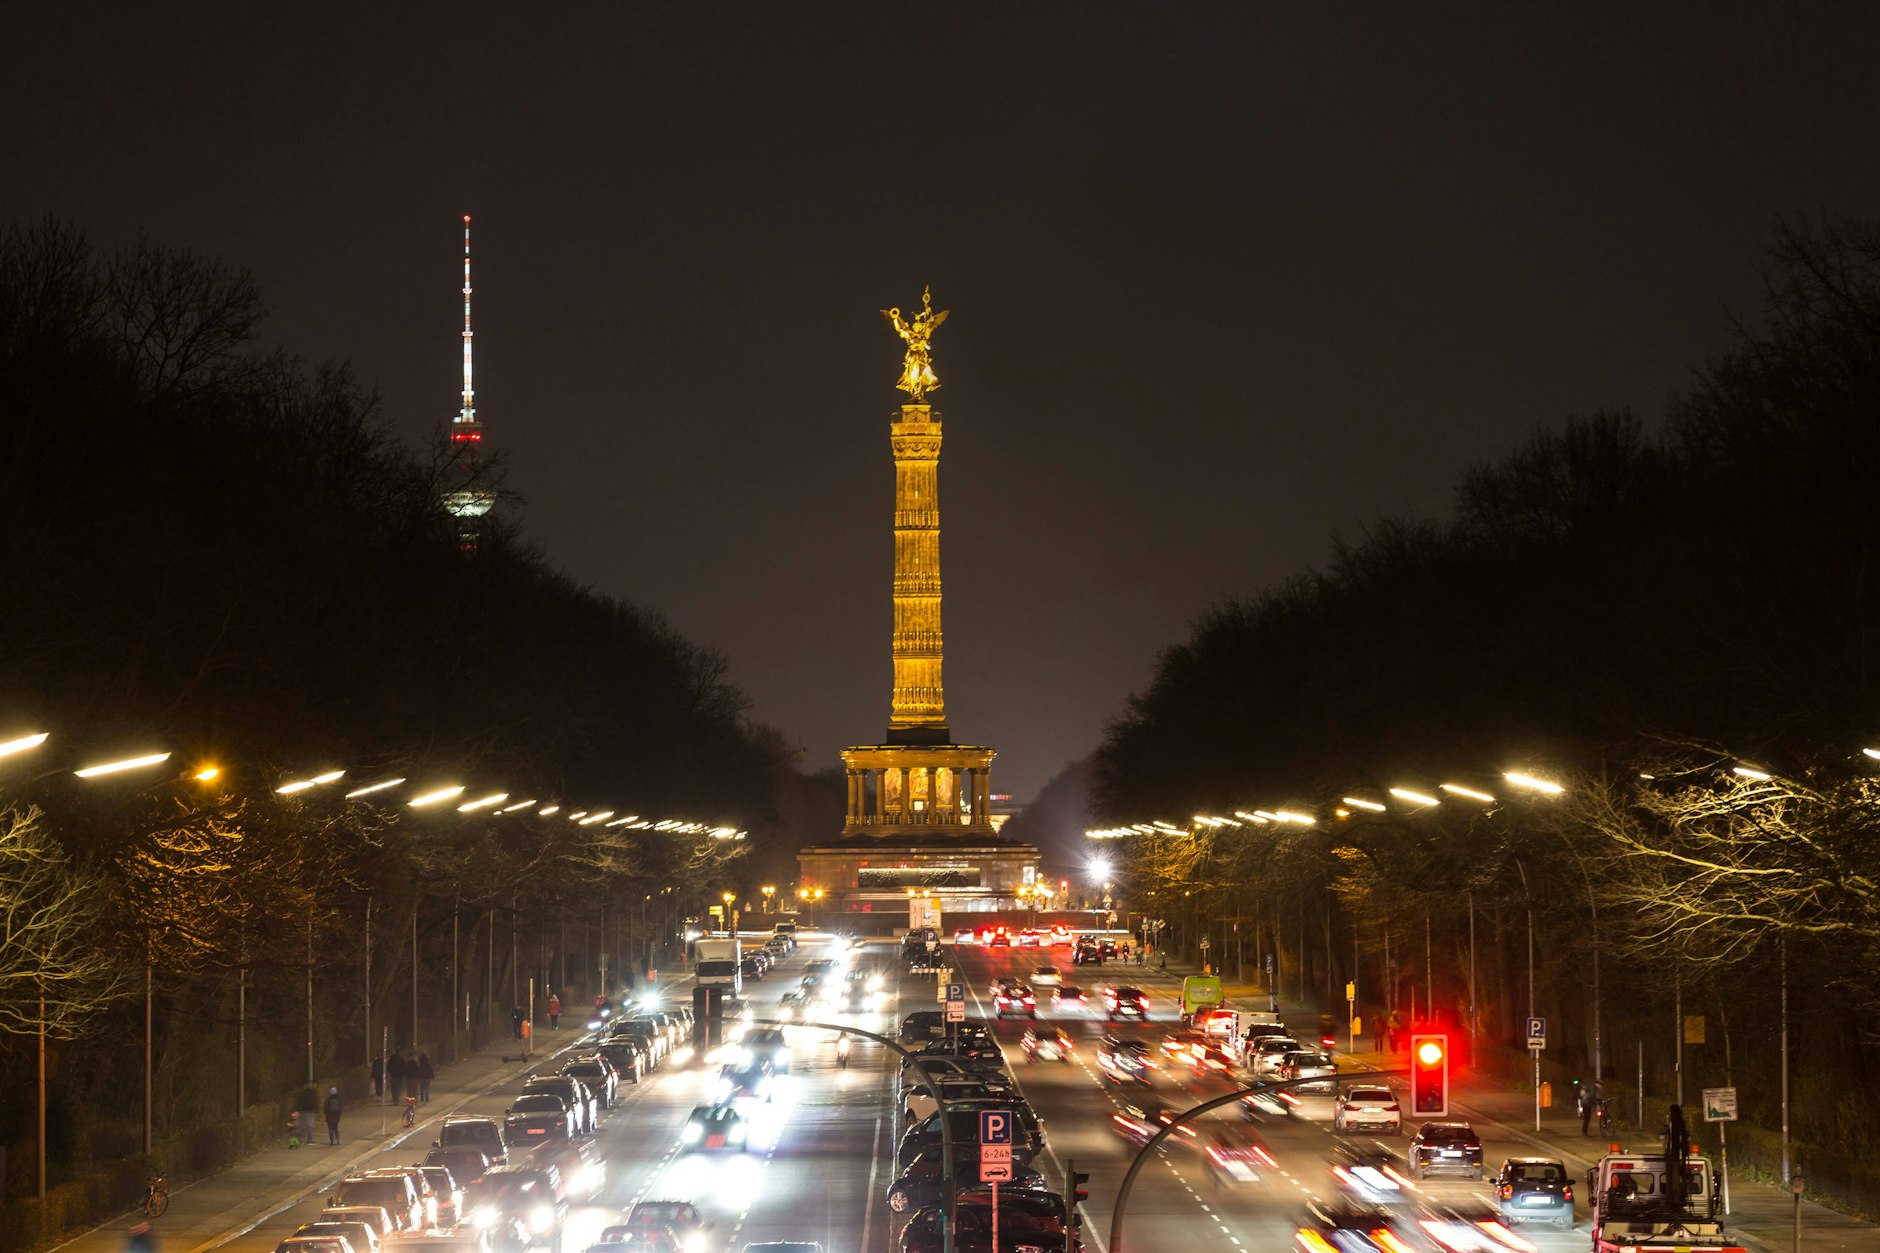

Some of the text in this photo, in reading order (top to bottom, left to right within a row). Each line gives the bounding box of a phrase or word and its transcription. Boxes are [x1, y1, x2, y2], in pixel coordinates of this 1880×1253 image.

[940, 974, 948, 986] P
[950, 985, 960, 999] P
[1531, 1020, 1541, 1036] P
[988, 1115, 1004, 1141] P
